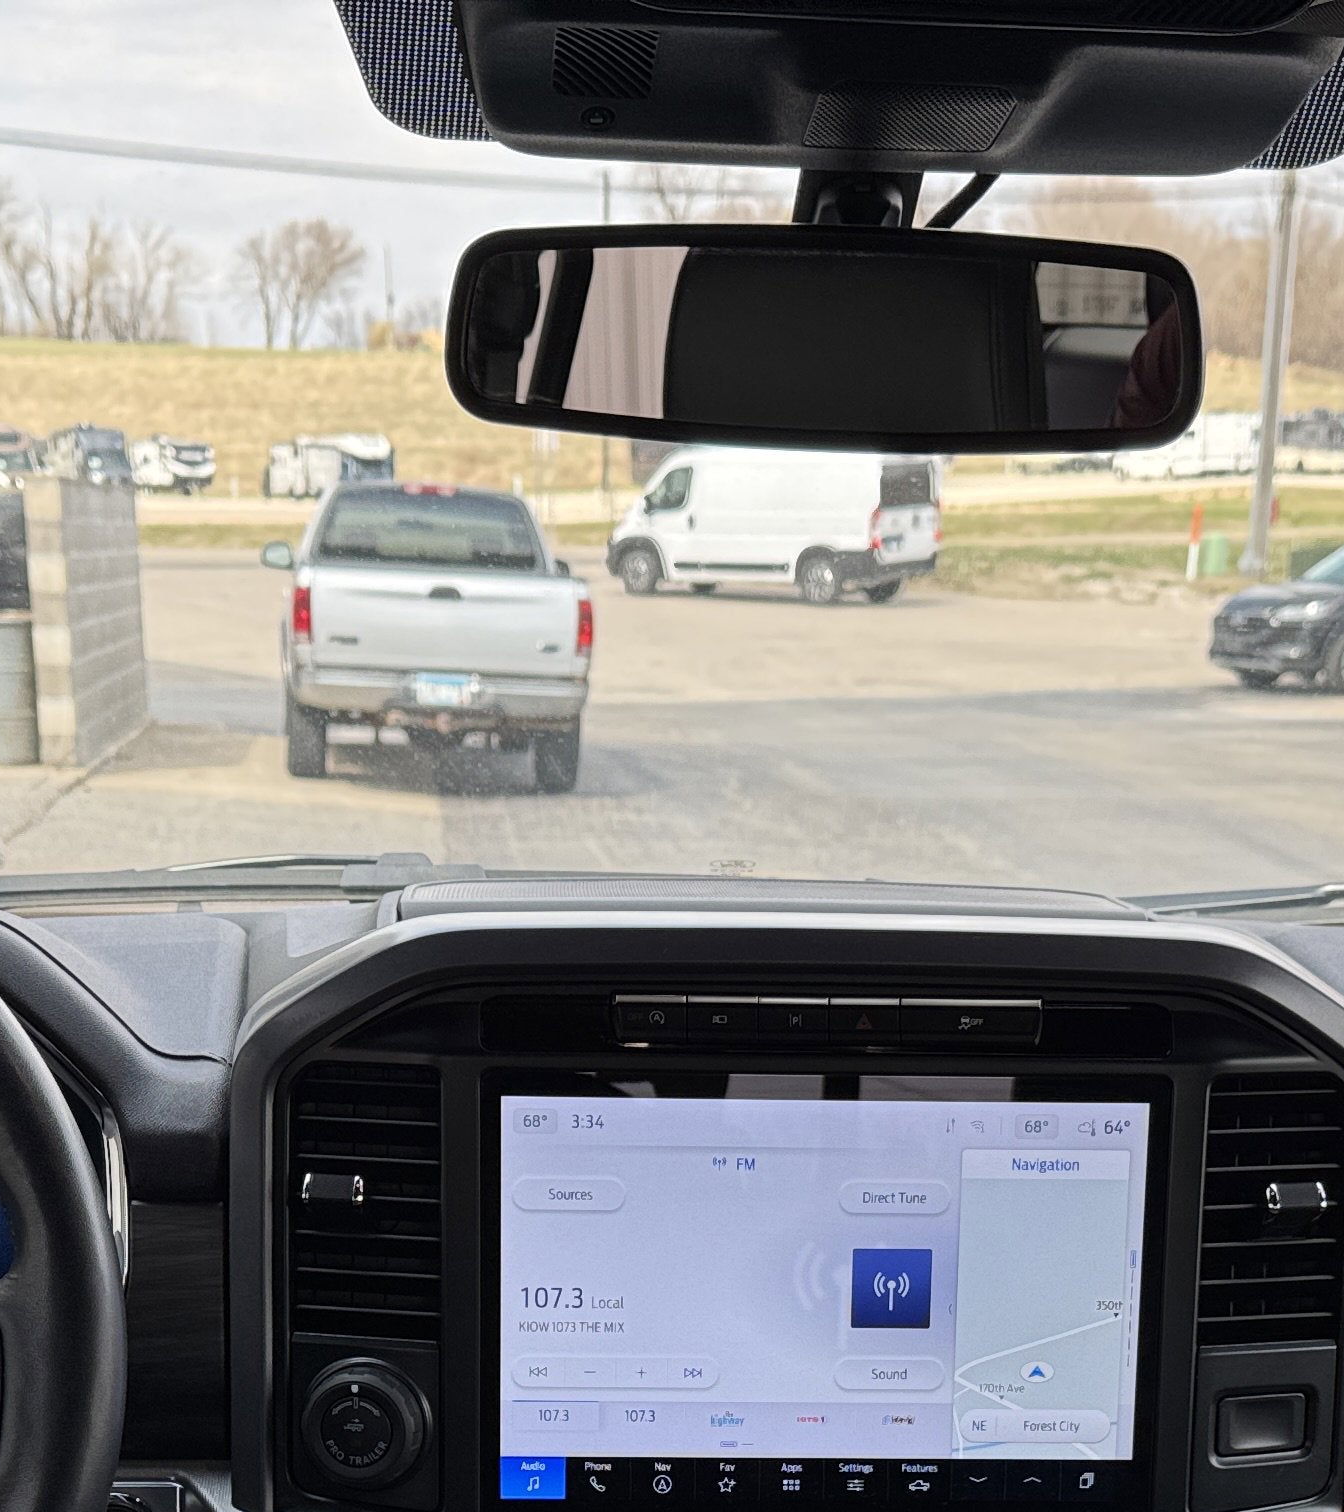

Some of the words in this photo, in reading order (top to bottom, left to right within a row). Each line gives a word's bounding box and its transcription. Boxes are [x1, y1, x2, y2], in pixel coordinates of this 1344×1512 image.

[571, 1114, 605, 1130] 3:34
[736, 1157, 756, 1171] FM
[1011, 1158, 1080, 1173] Navigation
[548, 1188, 593, 1201] Sources
[862, 1192, 896, 1204] Direct
[898, 1192, 927, 1204] Tune
[521, 1287, 584, 1309] 107.3
[591, 1296, 624, 1309] Local
[518, 1321, 550, 1333] KIOW
[552, 1321, 576, 1333] 1073
[580, 1321, 602, 1333] THE
[604, 1321, 625, 1333] MIX
[871, 1368, 908, 1380] Sound
[979, 1384, 1005, 1394] 170th
[1007, 1384, 1025, 1394] Ave
[538, 1409, 569, 1422] 107.3
[625, 1410, 656, 1423] 107.3
[972, 1420, 987, 1432] NE
[1023, 1420, 1057, 1432] Forest
[1059, 1420, 1080, 1433] City
[326, 1440, 345, 1460] PRO
[349, 1441, 388, 1466] TRAILER
[520, 1461, 546, 1471] Audio
[584, 1461, 612, 1471] Phone
[654, 1462, 672, 1472] Nav
[719, 1462, 736, 1472] Fav
[781, 1462, 803, 1473] Apps
[839, 1462, 873, 1474] Settings
[901, 1463, 938, 1473] Features
